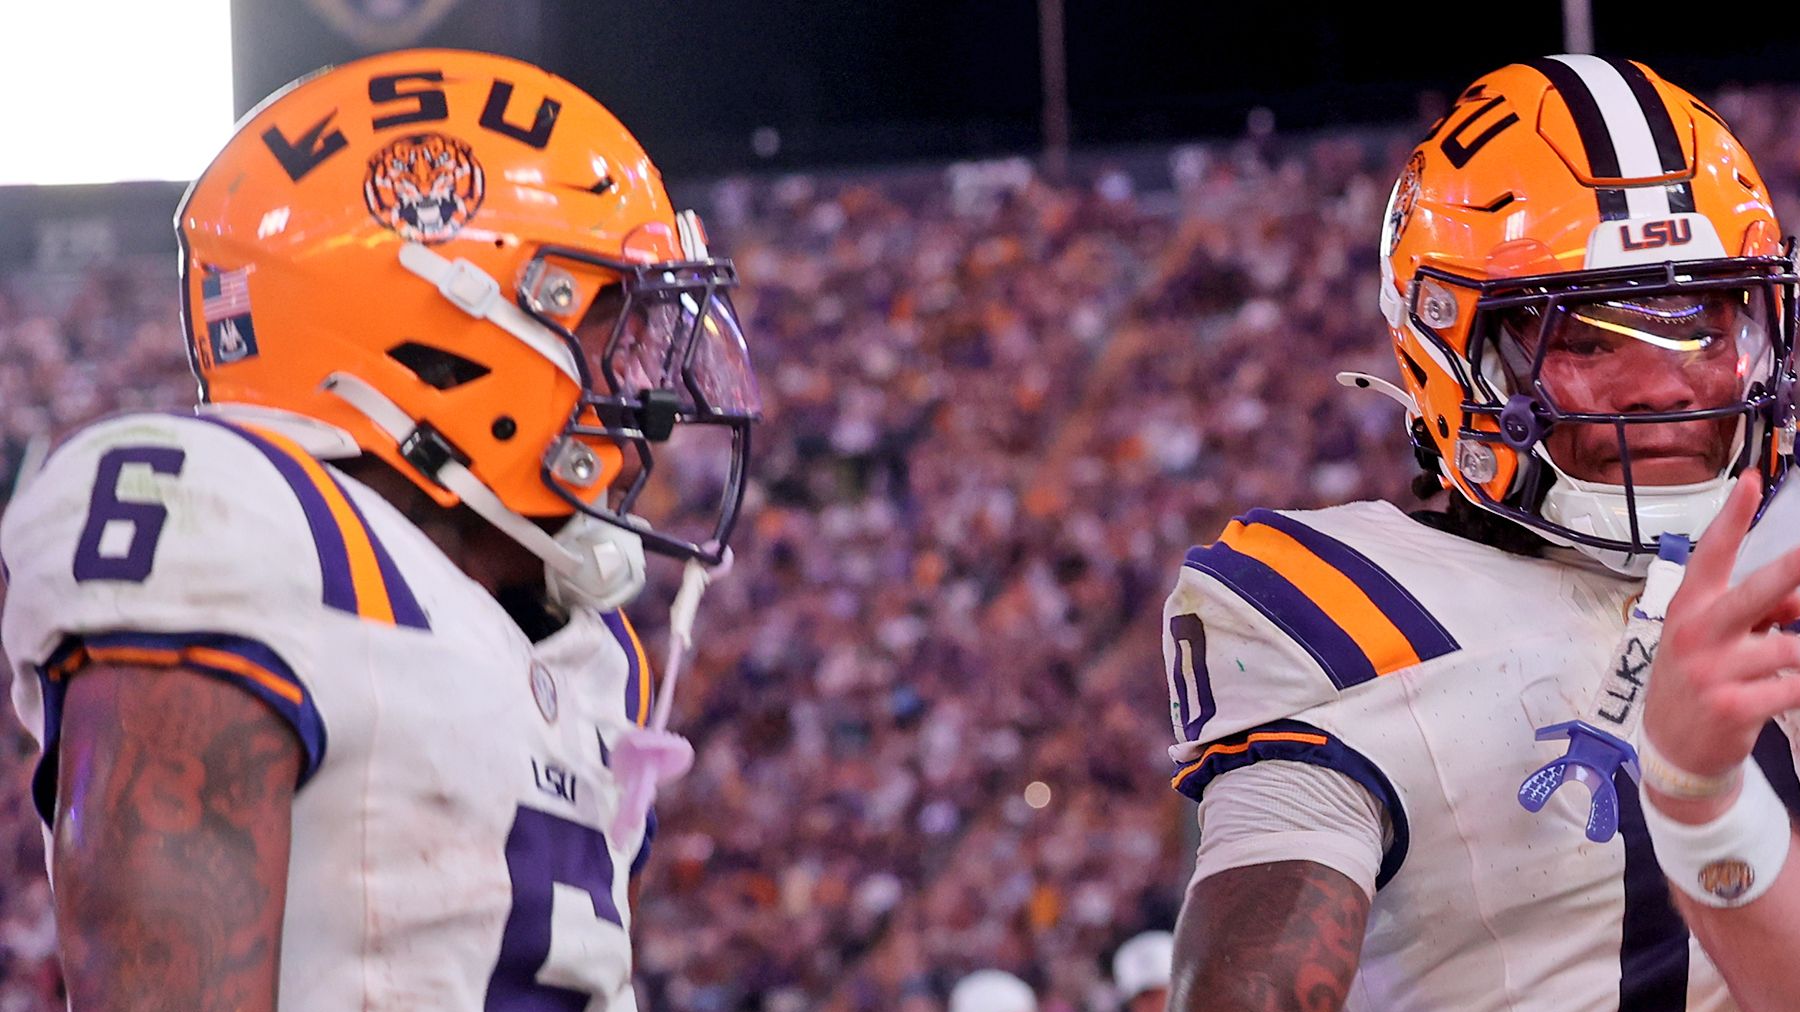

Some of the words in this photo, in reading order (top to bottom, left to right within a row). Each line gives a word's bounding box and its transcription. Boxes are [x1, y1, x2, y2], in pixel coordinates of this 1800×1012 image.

[261, 71, 562, 183] LSU
[1620, 219, 1692, 252] LSU
[73, 447, 186, 584] 6
[1170, 613, 1217, 742] 0
[531, 756, 576, 805] LSU
